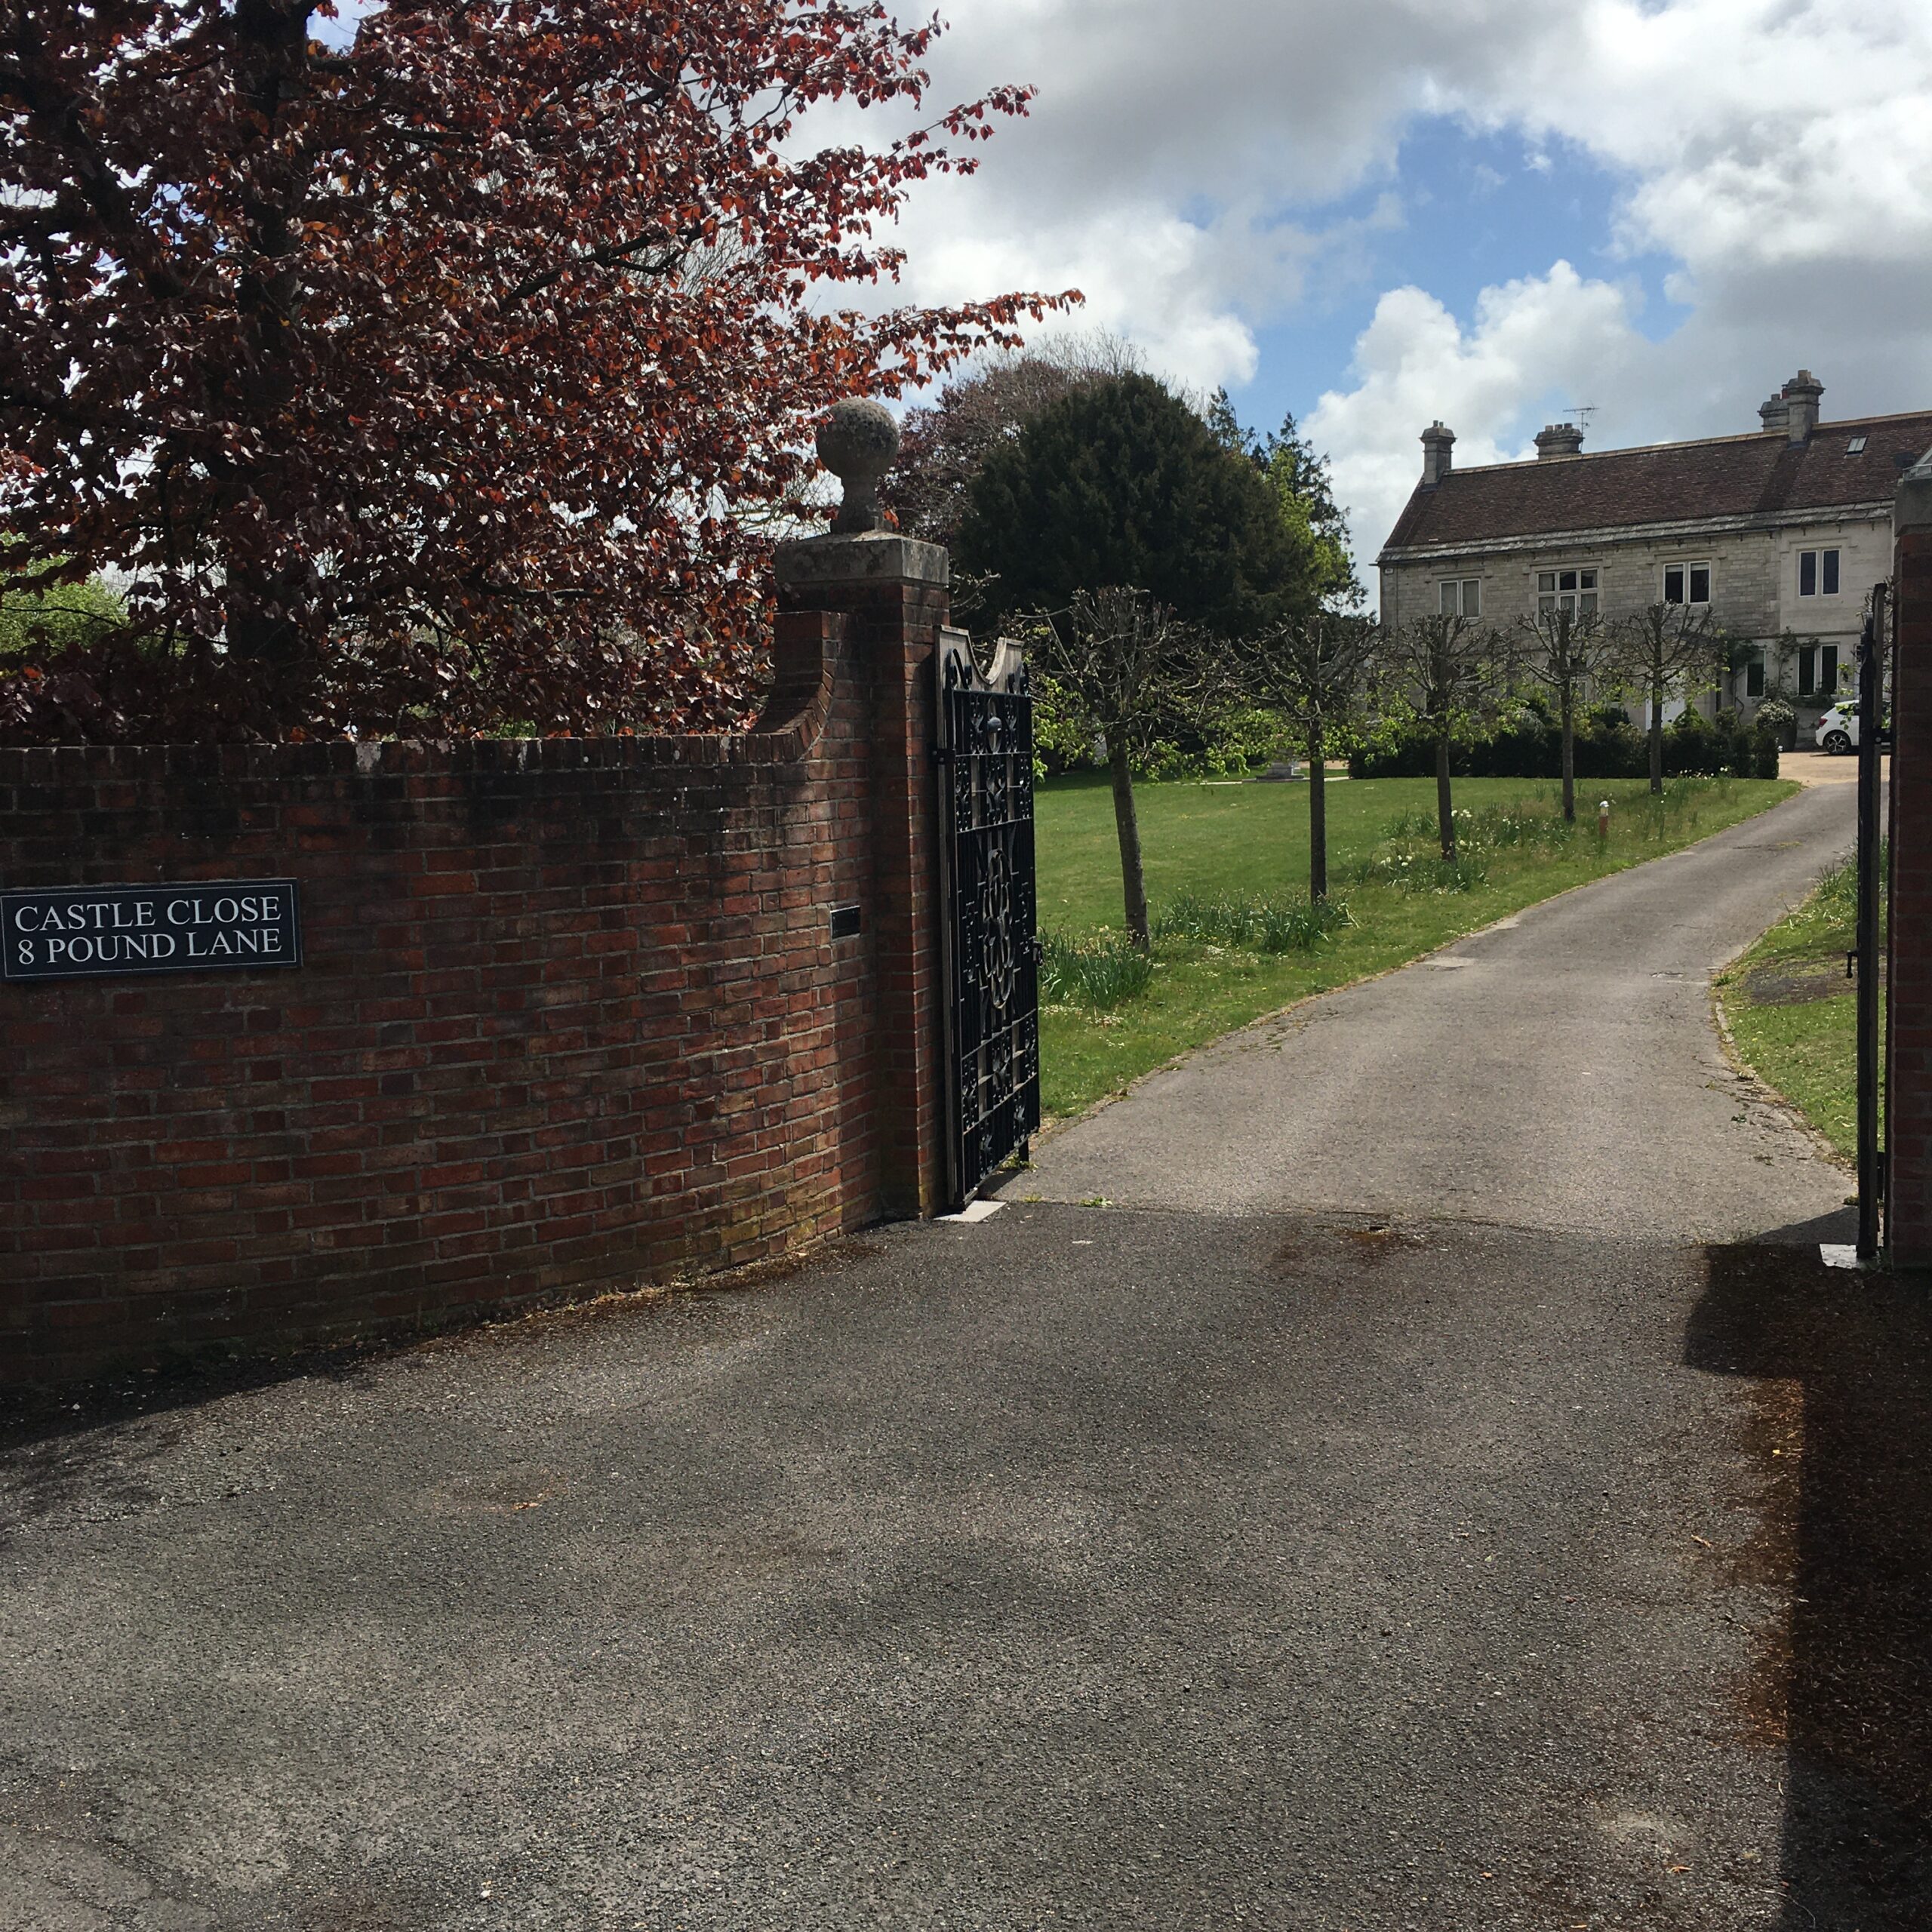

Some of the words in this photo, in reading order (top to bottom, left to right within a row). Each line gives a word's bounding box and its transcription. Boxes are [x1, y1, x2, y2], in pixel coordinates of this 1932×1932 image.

[15, 902, 156, 932] CASTLE
[167, 897, 282, 925] CLOSE
[18, 940, 35, 964] 8
[45, 934, 176, 963] POUND
[186, 928, 283, 957] LANE
